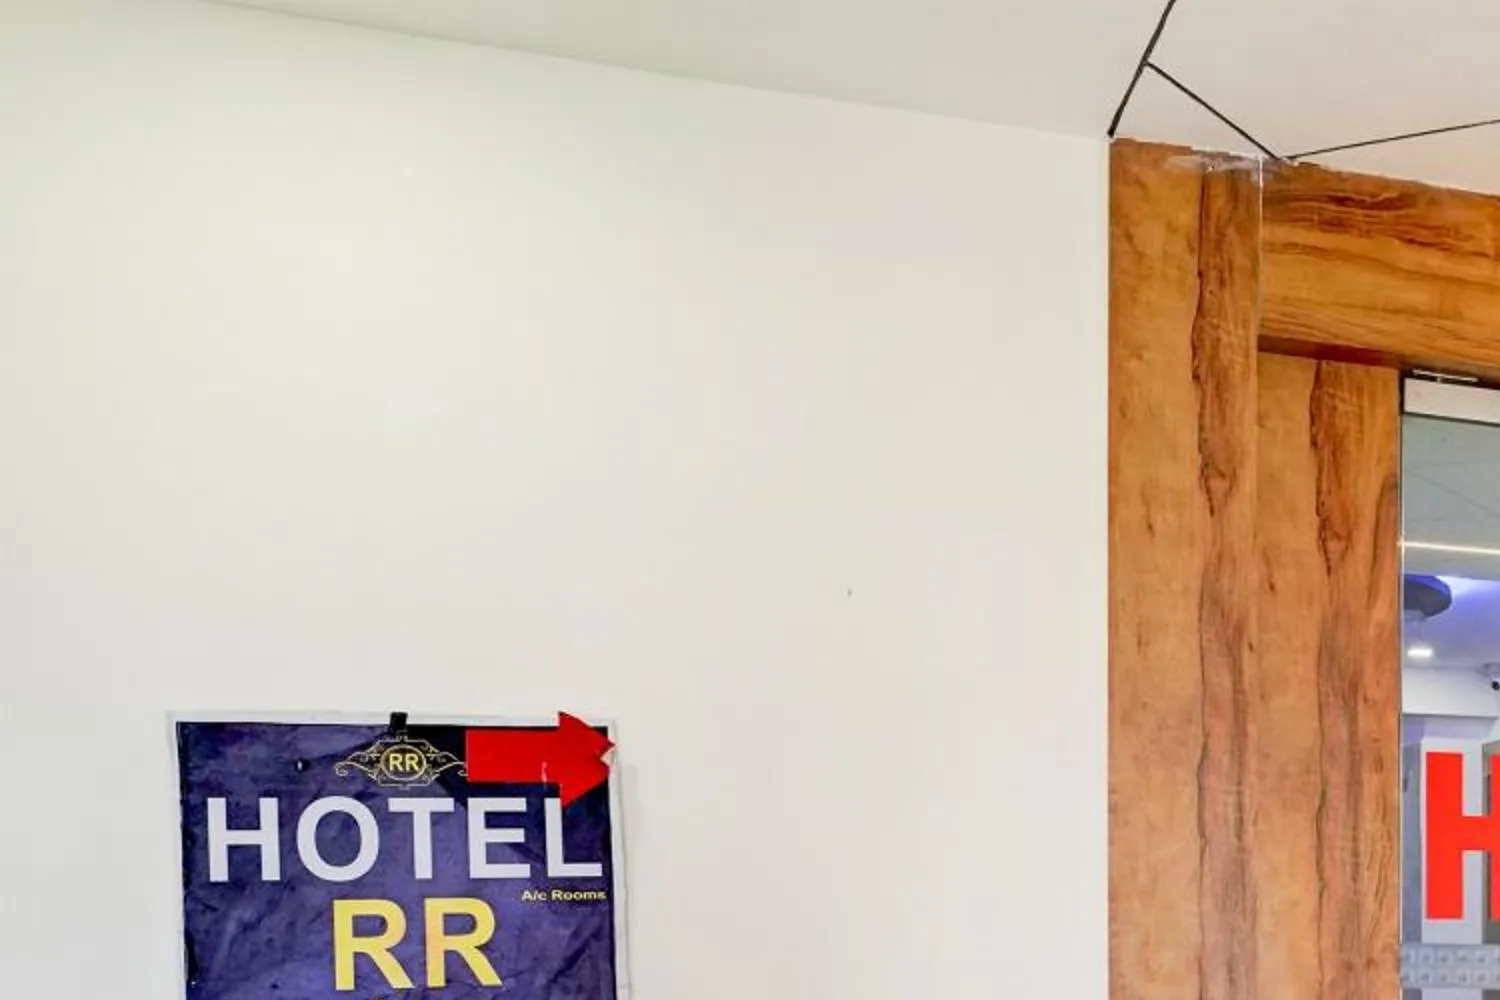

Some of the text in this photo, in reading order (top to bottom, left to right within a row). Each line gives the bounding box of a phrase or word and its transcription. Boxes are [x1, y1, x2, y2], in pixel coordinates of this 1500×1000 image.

[388, 752, 420, 773] RR
[207, 795, 603, 882] HOTEL
[550, 889, 607, 901] Rooms
[332, 896, 502, 990] RR
